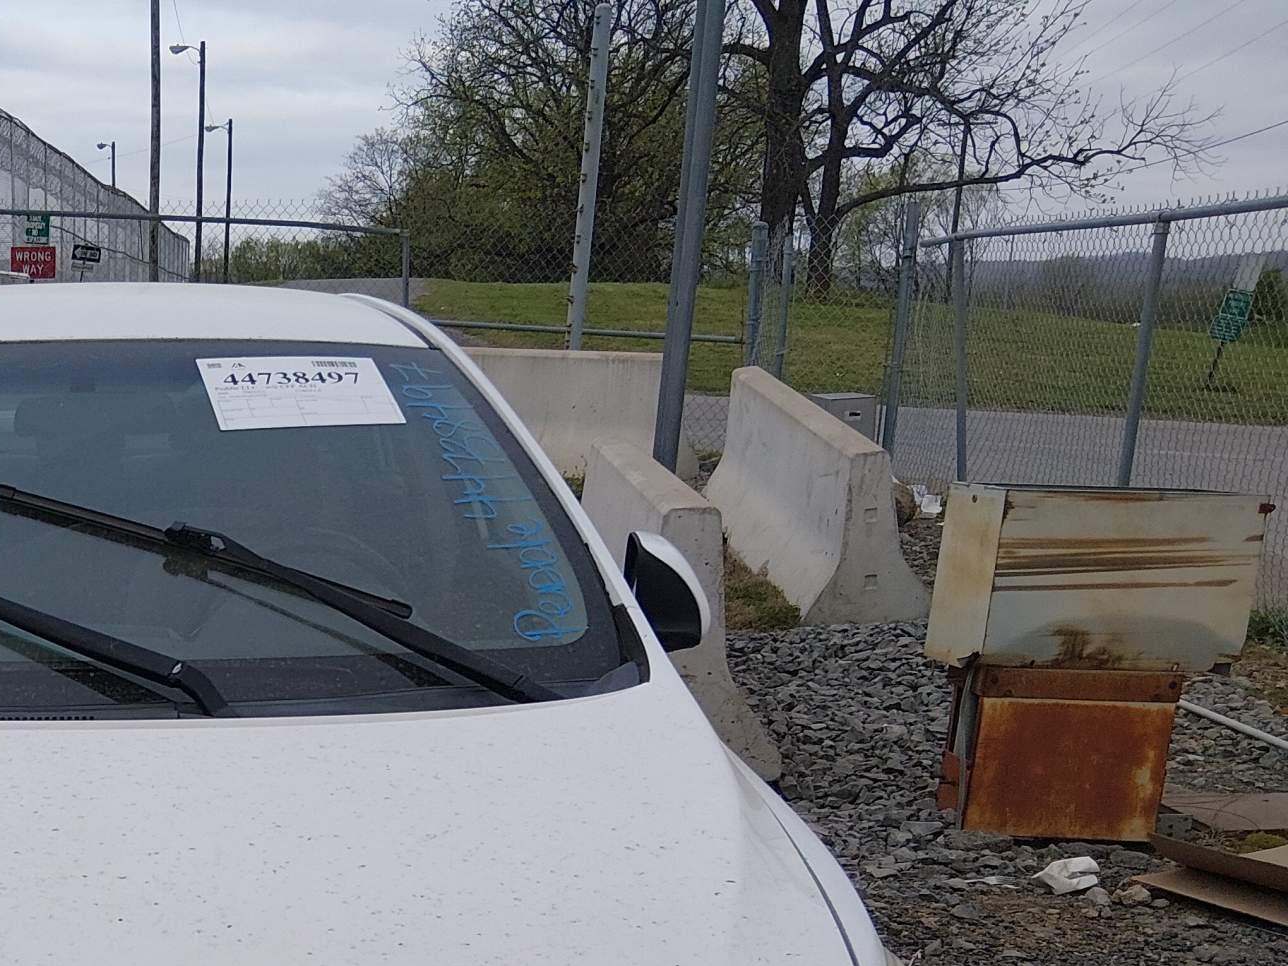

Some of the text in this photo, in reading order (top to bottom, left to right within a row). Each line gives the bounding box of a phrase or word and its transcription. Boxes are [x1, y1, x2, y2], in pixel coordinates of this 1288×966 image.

[15, 251, 52, 263] WRONG
[22, 264, 44, 275] WAY
[223, 371, 360, 386] 44738497
